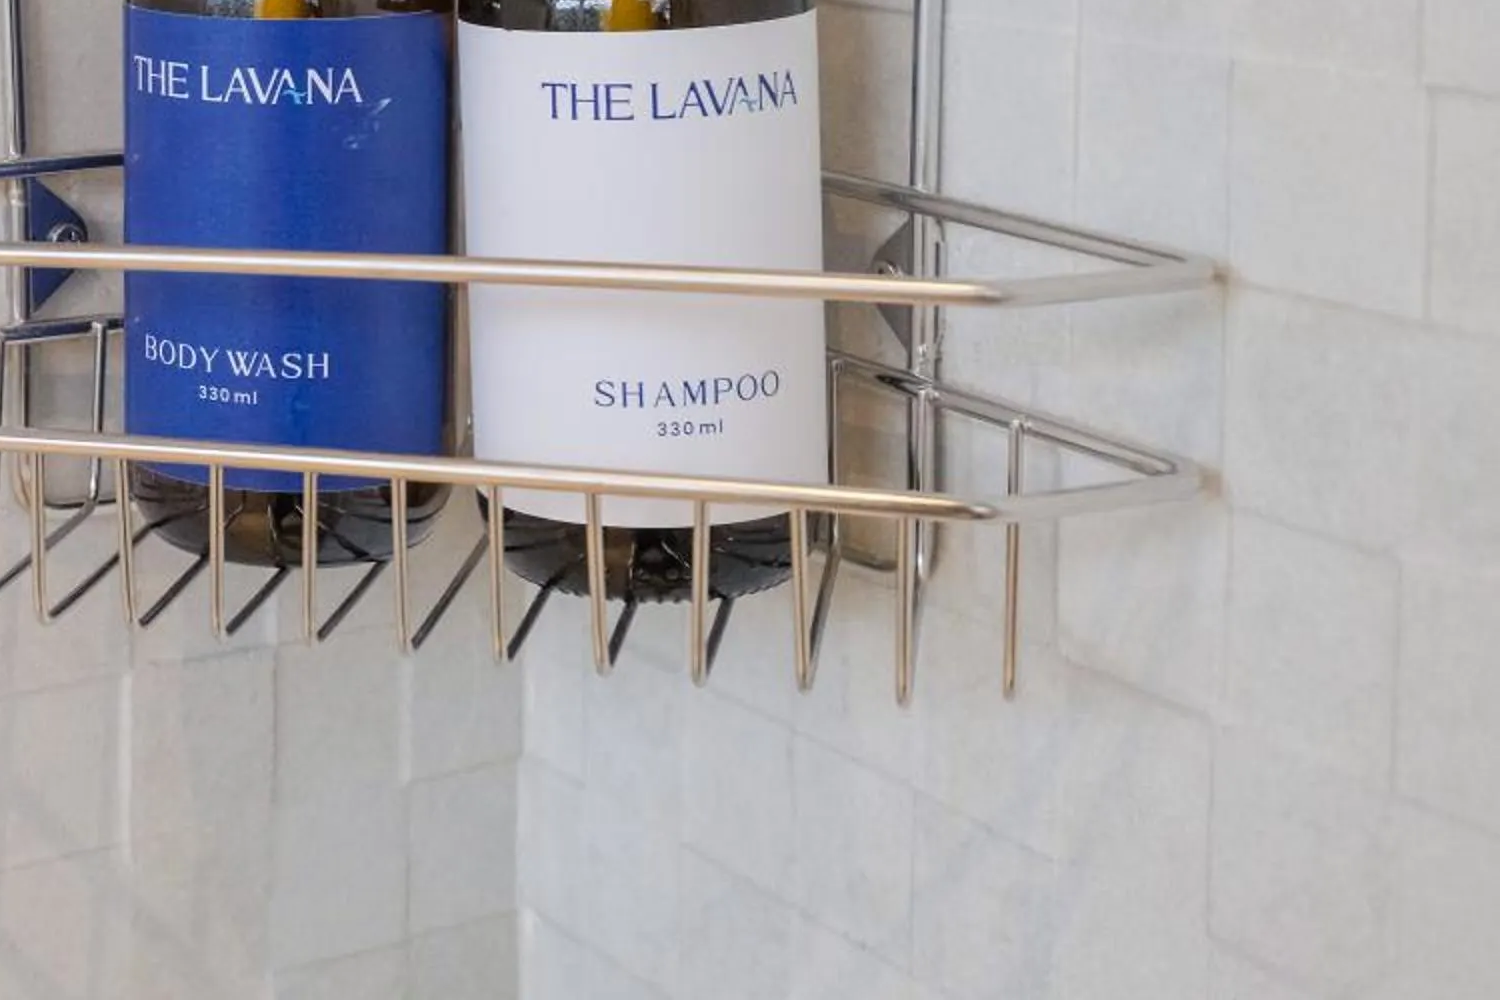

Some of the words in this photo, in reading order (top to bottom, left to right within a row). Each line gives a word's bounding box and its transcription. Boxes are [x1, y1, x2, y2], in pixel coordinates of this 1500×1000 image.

[133, 55, 190, 99] THE
[200, 65, 363, 105] LAVANA
[540, 82, 635, 121] THE
[650, 69, 798, 120] LAVANA
[144, 333, 221, 373] BODY
[225, 349, 330, 380] WASH
[593, 369, 781, 409] SHAMPOO
